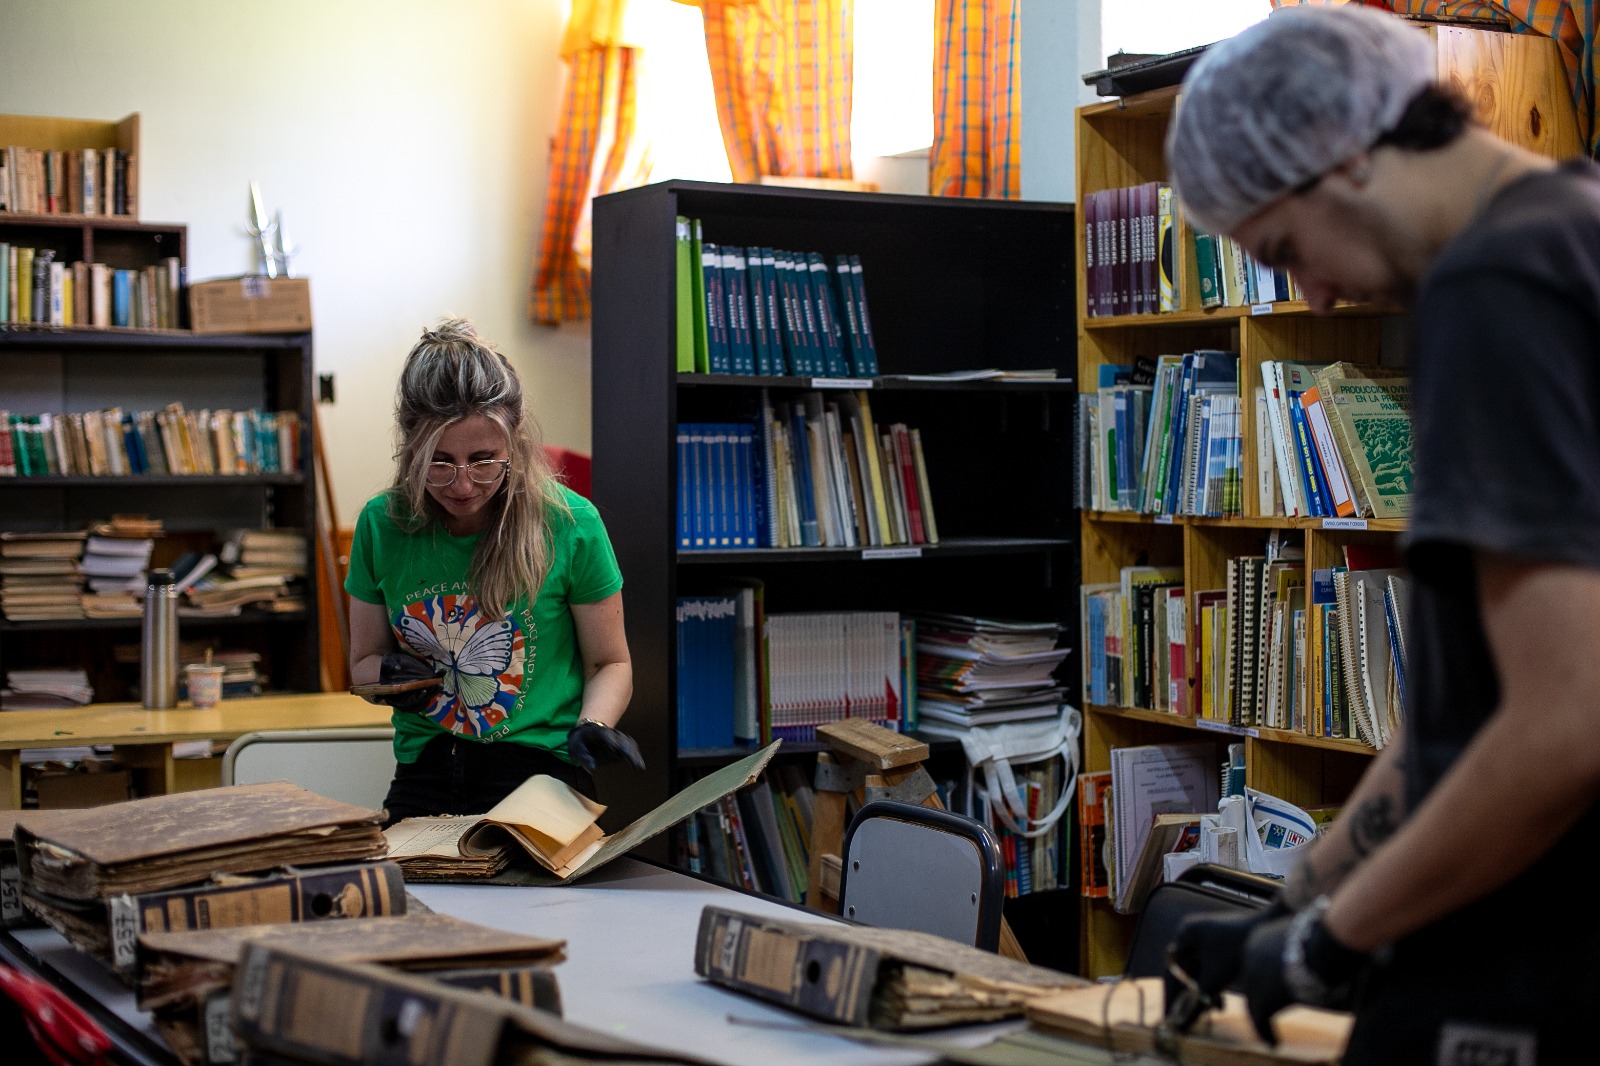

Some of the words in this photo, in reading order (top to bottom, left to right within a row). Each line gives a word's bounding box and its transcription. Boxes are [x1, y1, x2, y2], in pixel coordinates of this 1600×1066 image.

[1340, 385, 1389, 394] PRODUCCION
[1355, 395, 1367, 403] EN
[1369, 395, 1380, 403] LA
[405, 583, 448, 602] PEACE
[451, 581, 474, 591] AN
[520, 608, 539, 643] PEACE
[527, 645, 537, 674] AND
[515, 677, 533, 712] LOVE
[475, 724, 510, 744] PEAC
[2, 877, 19, 910] 251
